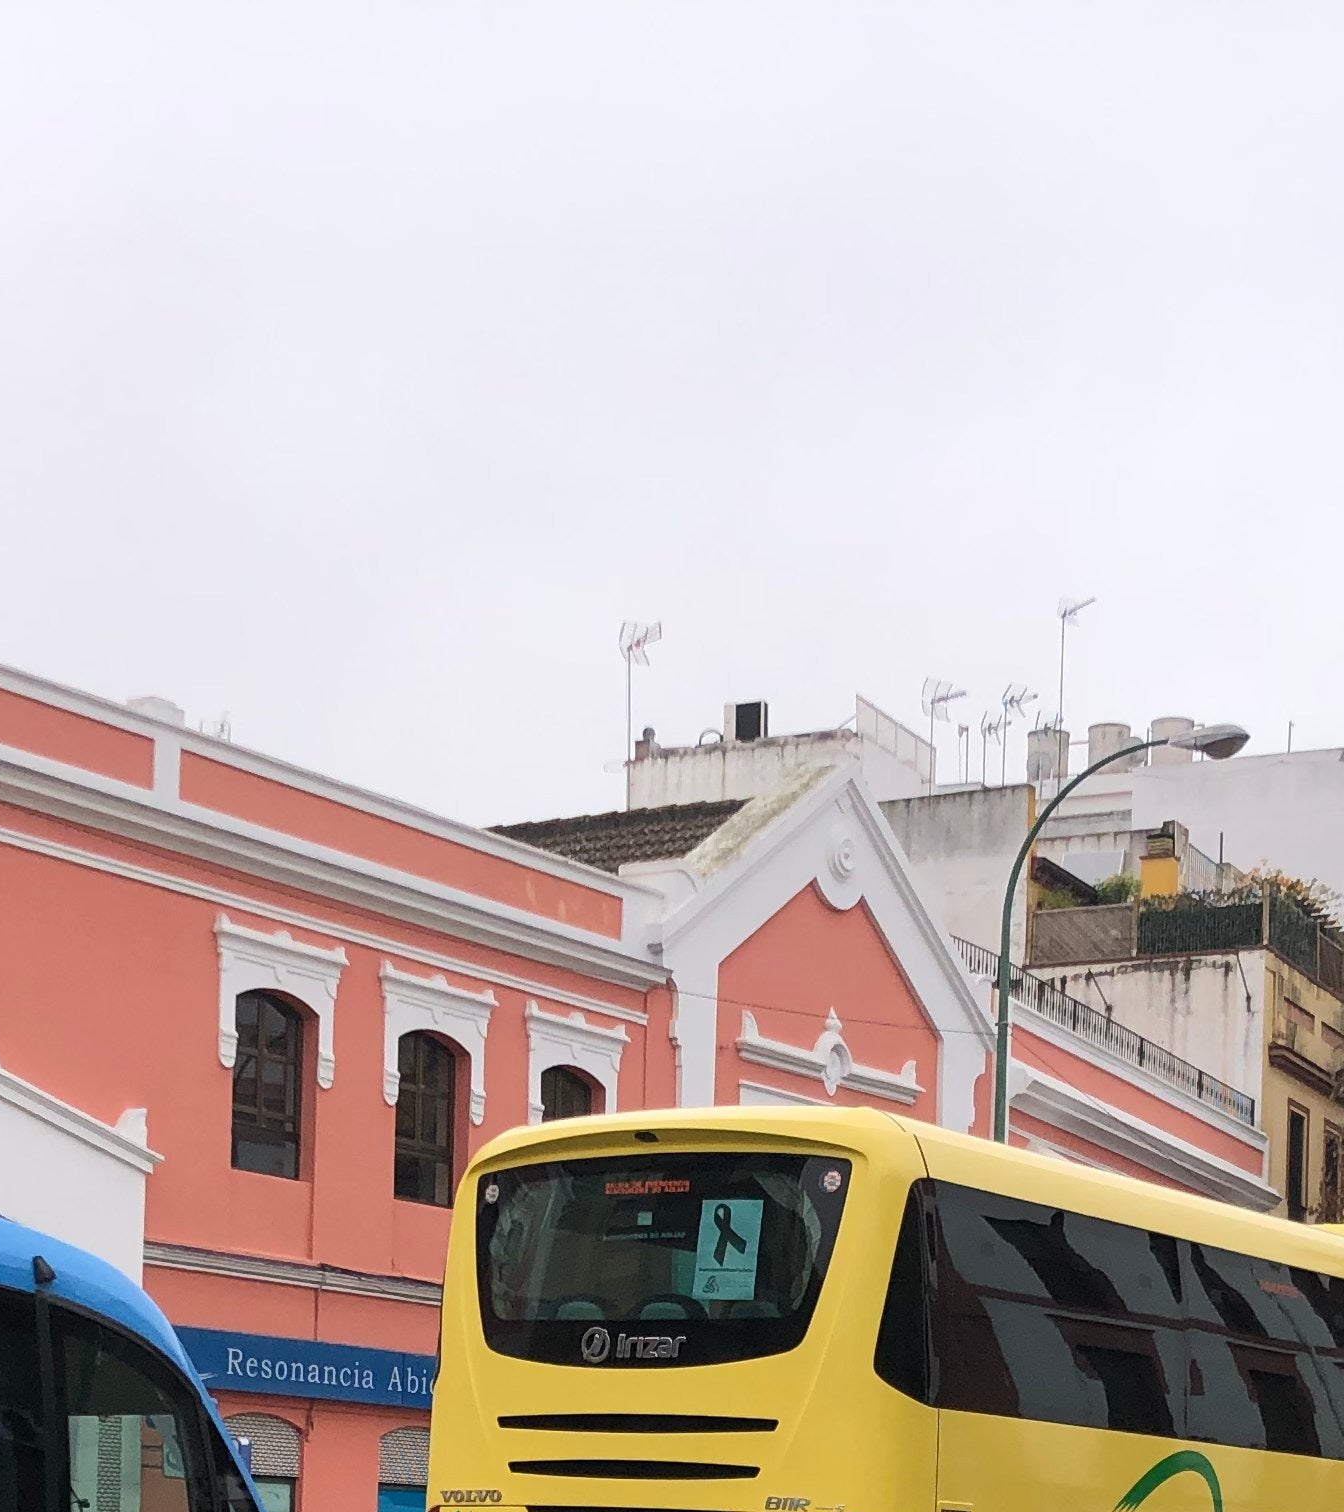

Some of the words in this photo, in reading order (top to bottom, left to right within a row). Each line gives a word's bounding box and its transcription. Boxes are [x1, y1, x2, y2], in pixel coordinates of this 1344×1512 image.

[615, 1333, 687, 1359] Irizar
[226, 1347, 374, 1390] Resonancia
[440, 1489, 503, 1503] VOLVO
